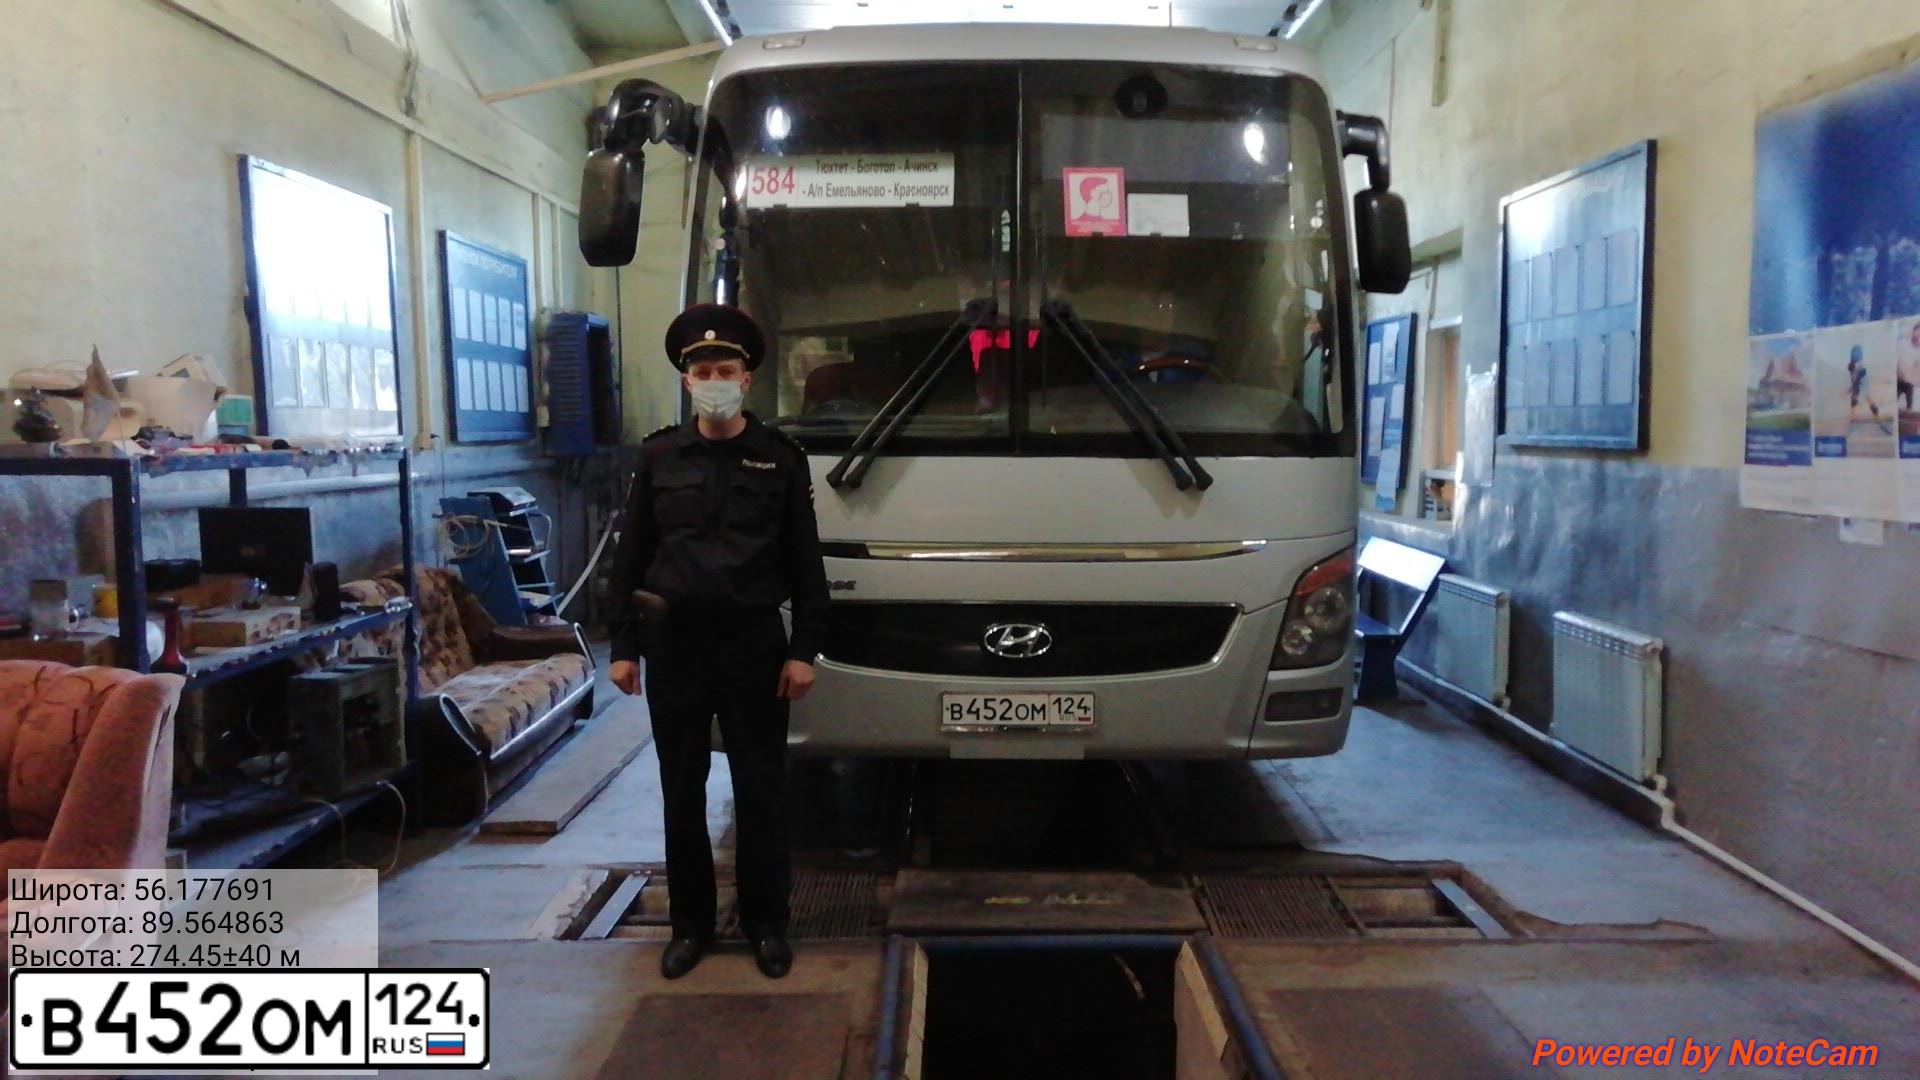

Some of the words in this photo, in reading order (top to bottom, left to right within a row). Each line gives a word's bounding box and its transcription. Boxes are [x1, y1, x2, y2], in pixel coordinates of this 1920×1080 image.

[816, 160, 849, 174] Тюхтет
[904, 159, 938, 174] Ачинск
[751, 165, 795, 195] 584
[826, 183, 886, 198] Емельяново
[894, 183, 950, 199] Красноярск
[1052, 697, 1088, 715] 124
